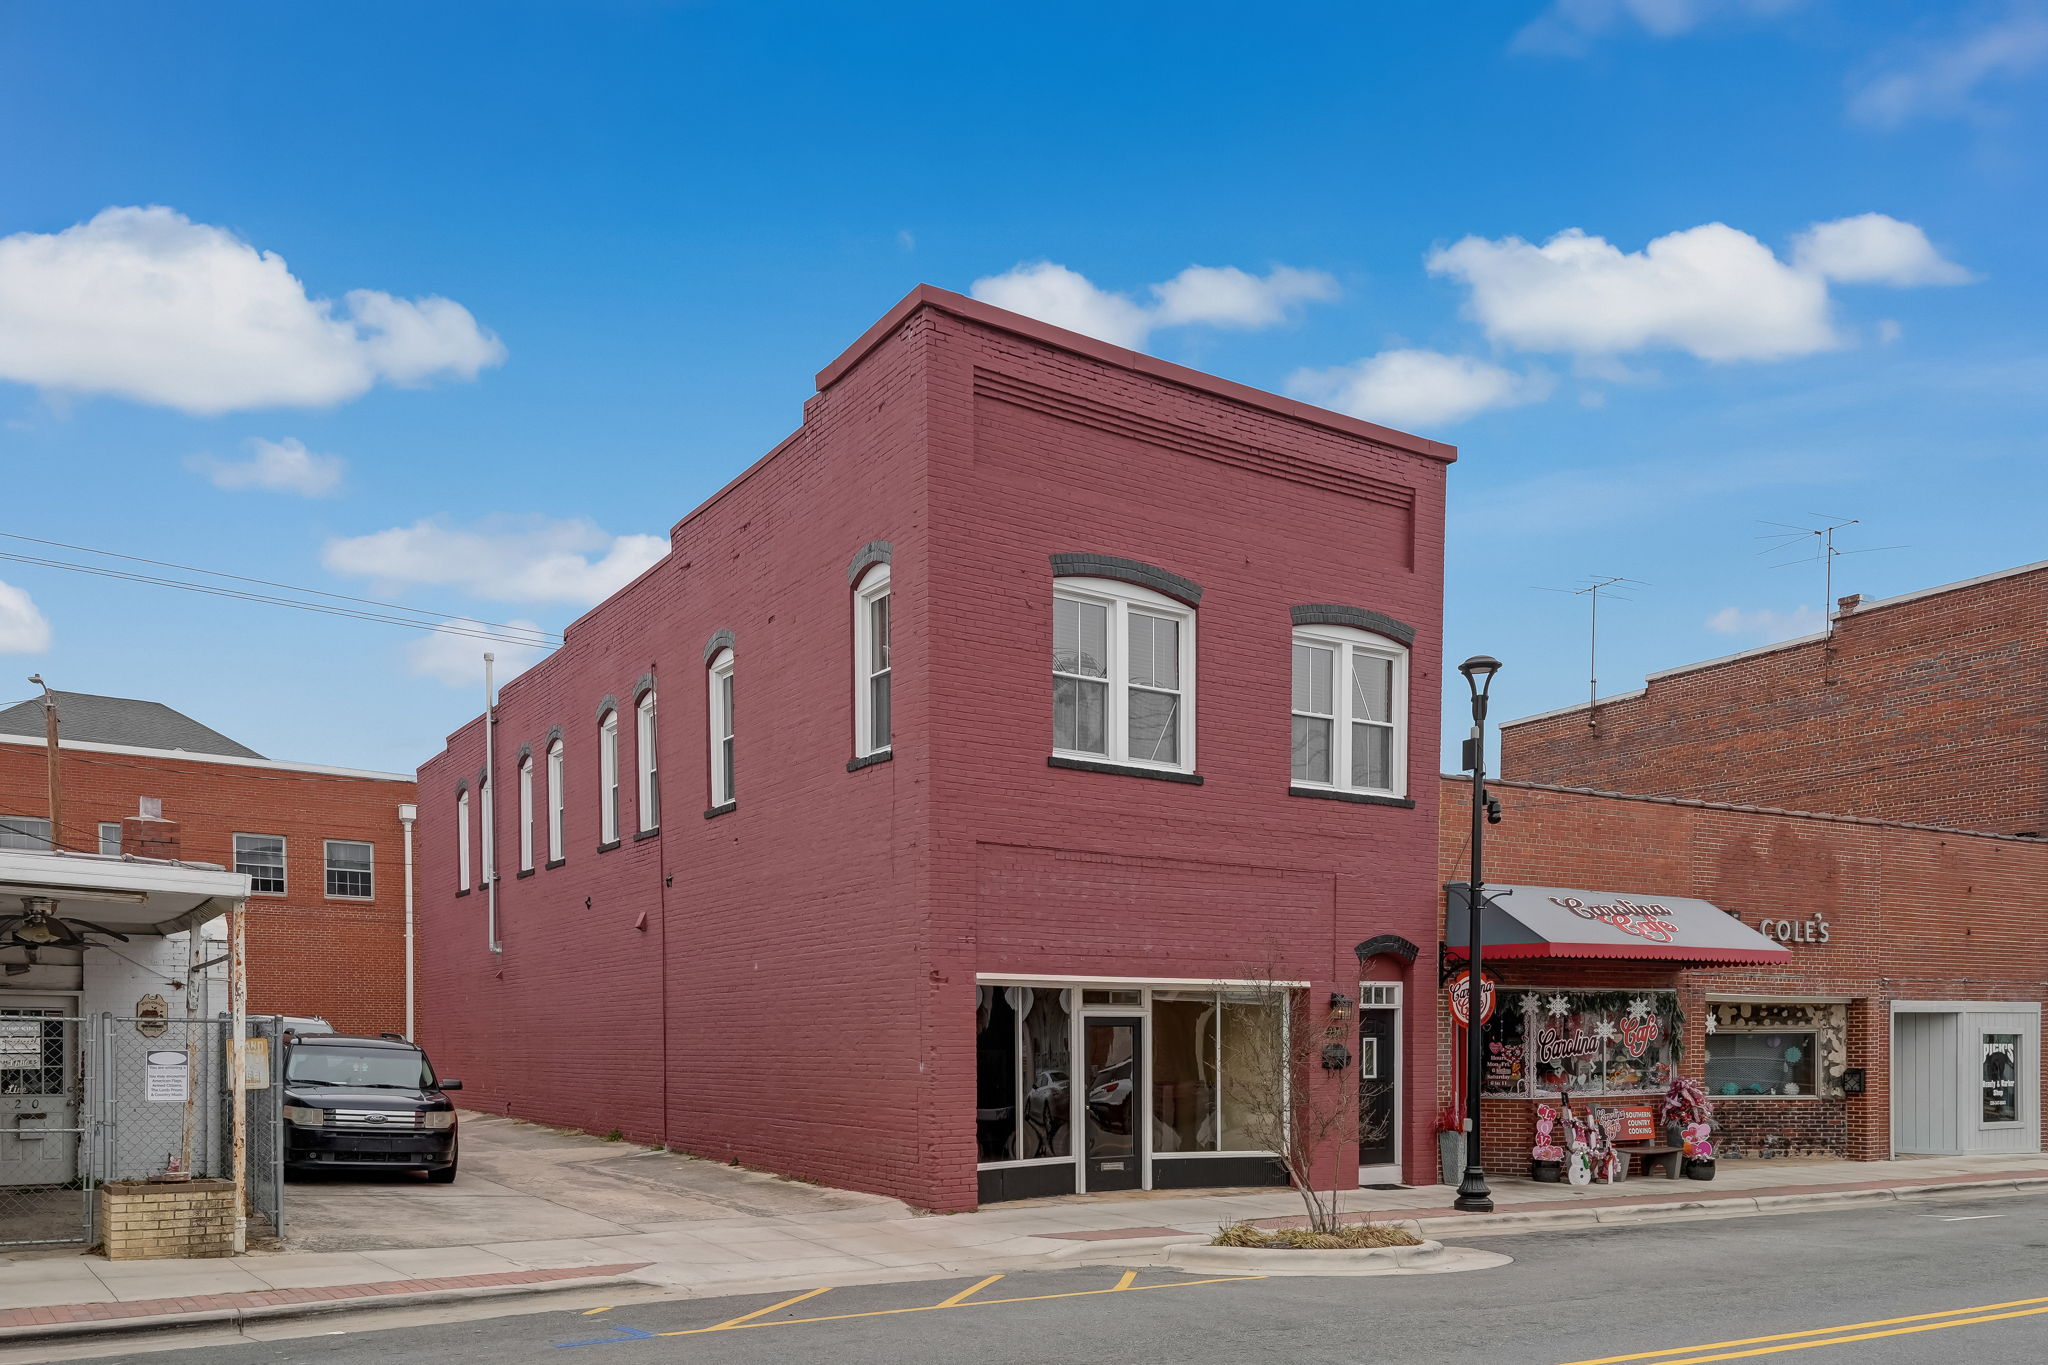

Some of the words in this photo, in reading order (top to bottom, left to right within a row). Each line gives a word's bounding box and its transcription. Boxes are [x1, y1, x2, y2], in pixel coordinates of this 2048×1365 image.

[1548, 897, 1674, 920] Carolina
[1595, 914, 1679, 942] Cafe
[1759, 912, 1830, 943] COLE'S
[1538, 1028, 1600, 1064] Carolina
[1620, 1014, 1659, 1058] Cafe
[1627, 1119, 1650, 1127] COUNTRY
[1628, 1127, 1653, 1135] COOKING
